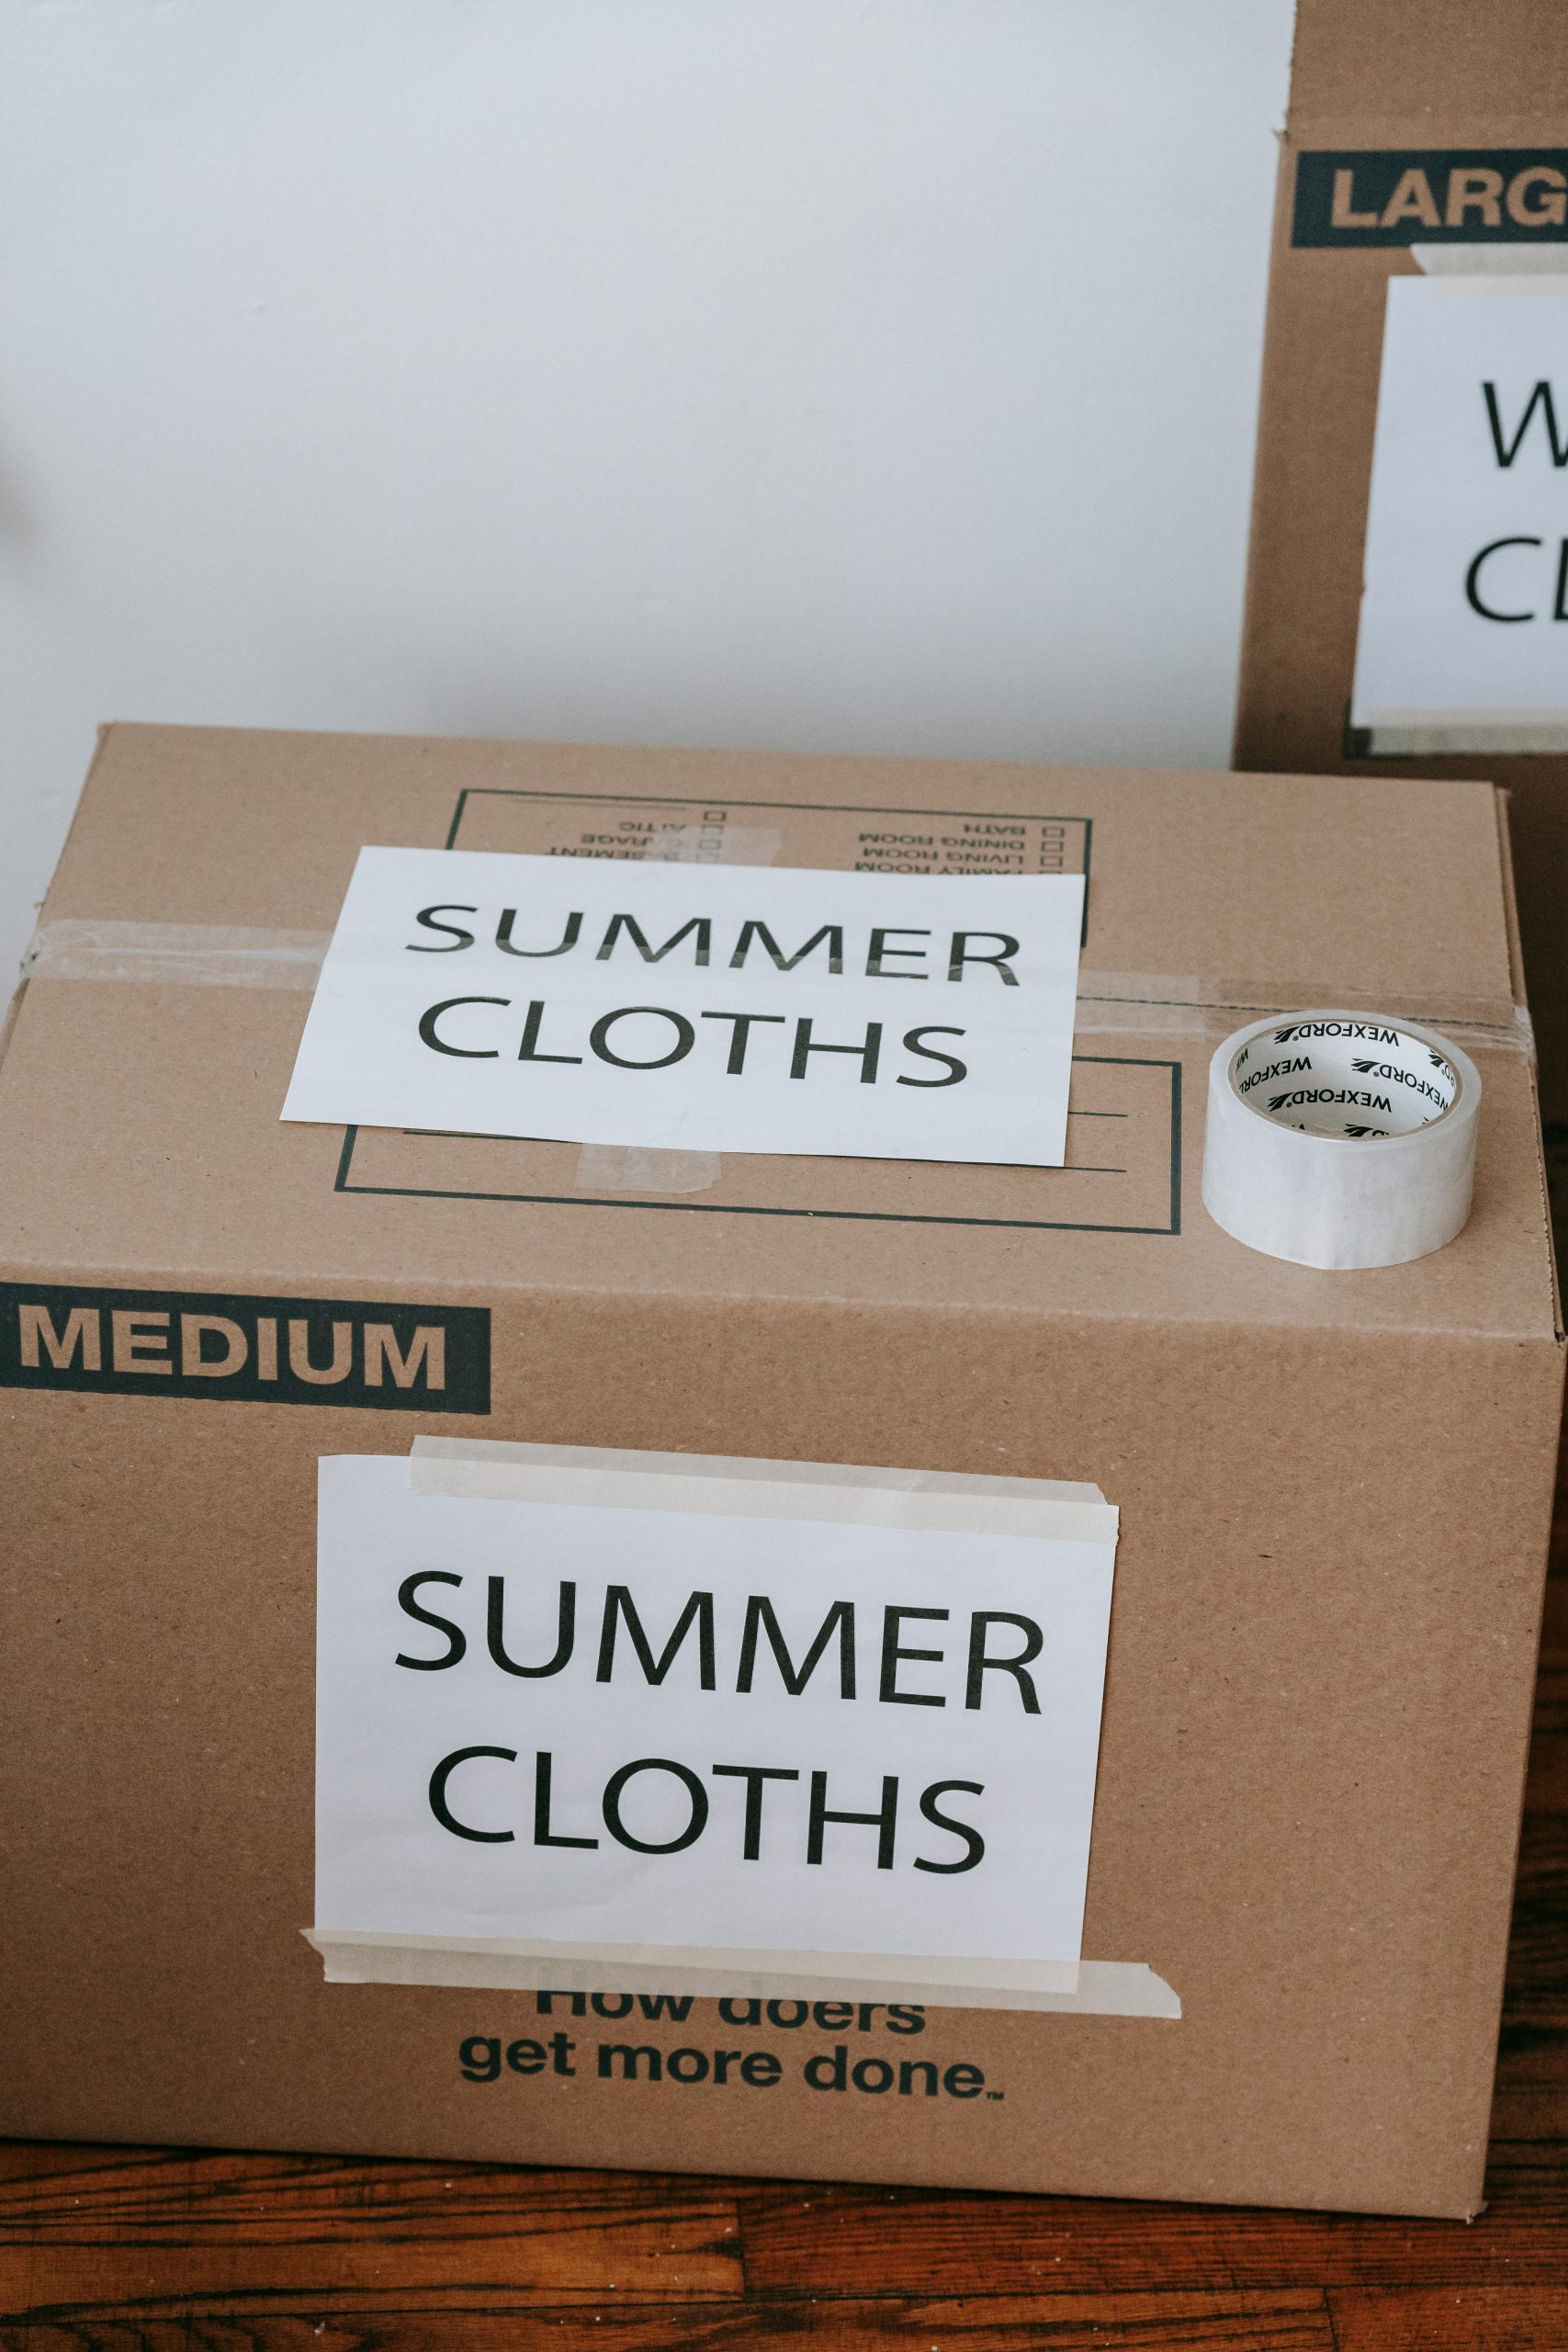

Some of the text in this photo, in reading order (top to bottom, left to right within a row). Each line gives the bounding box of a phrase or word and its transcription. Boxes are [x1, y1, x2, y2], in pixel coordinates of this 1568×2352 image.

[1330, 167, 1568, 227] LARG
[859, 833, 1025, 850] DINING ROOM
[863, 848, 1023, 864] LIVING ROOM
[964, 824, 1025, 835] BATH
[855, 862, 930, 874] ROOM
[406, 904, 1021, 986] SUMMER
[418, 997, 967, 1088] CLOTHS
[18, 1304, 446, 1390] MEDIUM
[395, 1570, 1043, 1714] SUMMER
[428, 1746, 986, 1874] CLOTHS
[459, 2031, 577, 2082] get
[597, 2044, 782, 2086] more
